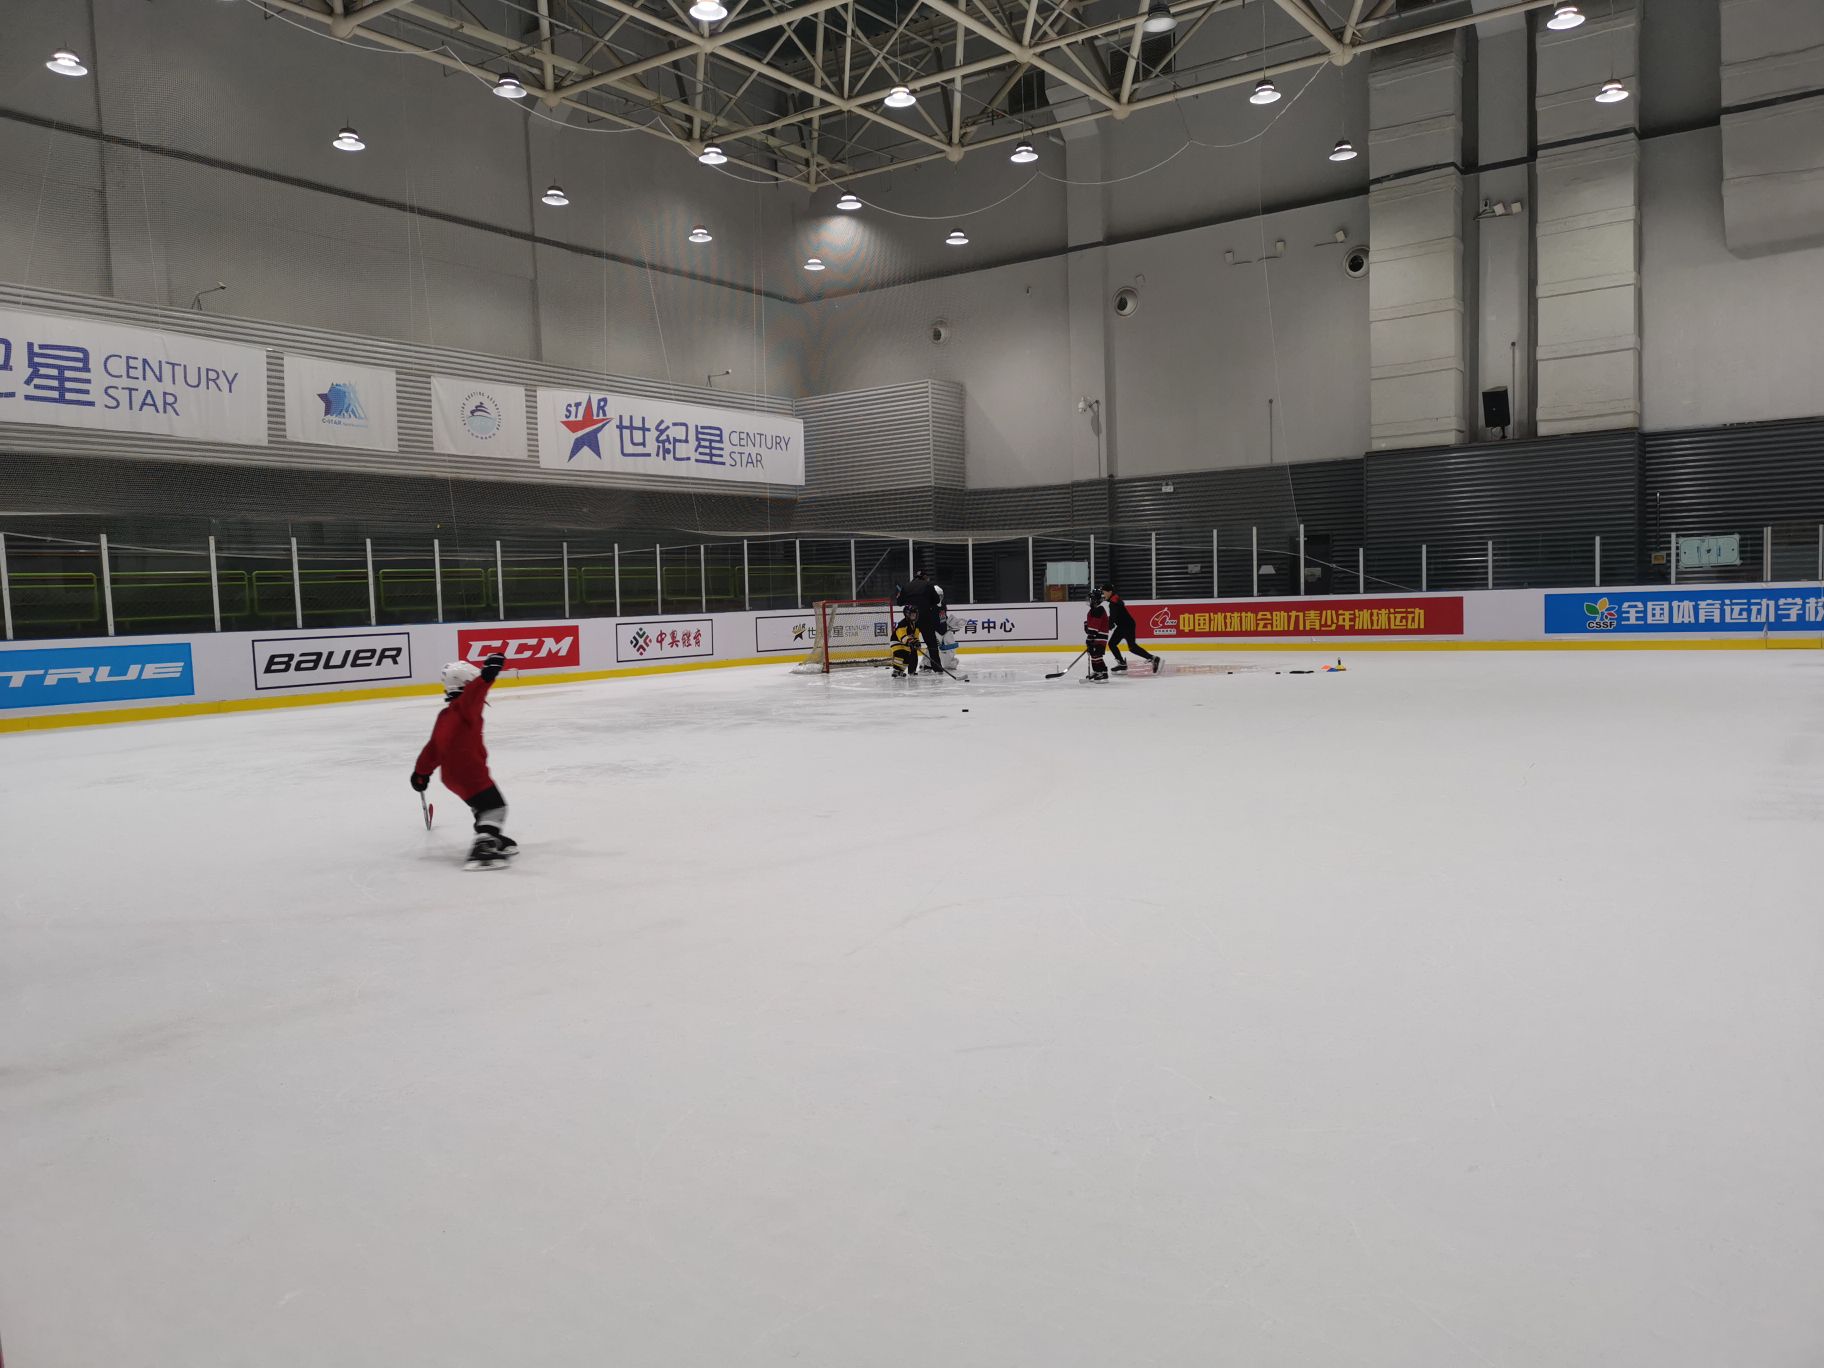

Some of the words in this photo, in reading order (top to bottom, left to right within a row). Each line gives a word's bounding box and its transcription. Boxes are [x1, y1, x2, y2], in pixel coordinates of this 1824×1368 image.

[0, 338, 96, 407] 星
[103, 354, 239, 394] CENTURY
[103, 386, 181, 416] STAR
[564, 394, 608, 419] STAR
[728, 430, 791, 451] CENTURY
[728, 450, 765, 469] STAR
[1179, 608, 1424, 632] 中国冰球协会助力青少年冰球运动
[1586, 620, 1616, 630] CSSF
[263, 647, 402, 674] BAUER
[466, 636, 574, 662] CCM
[0, 662, 185, 688] TRUE
